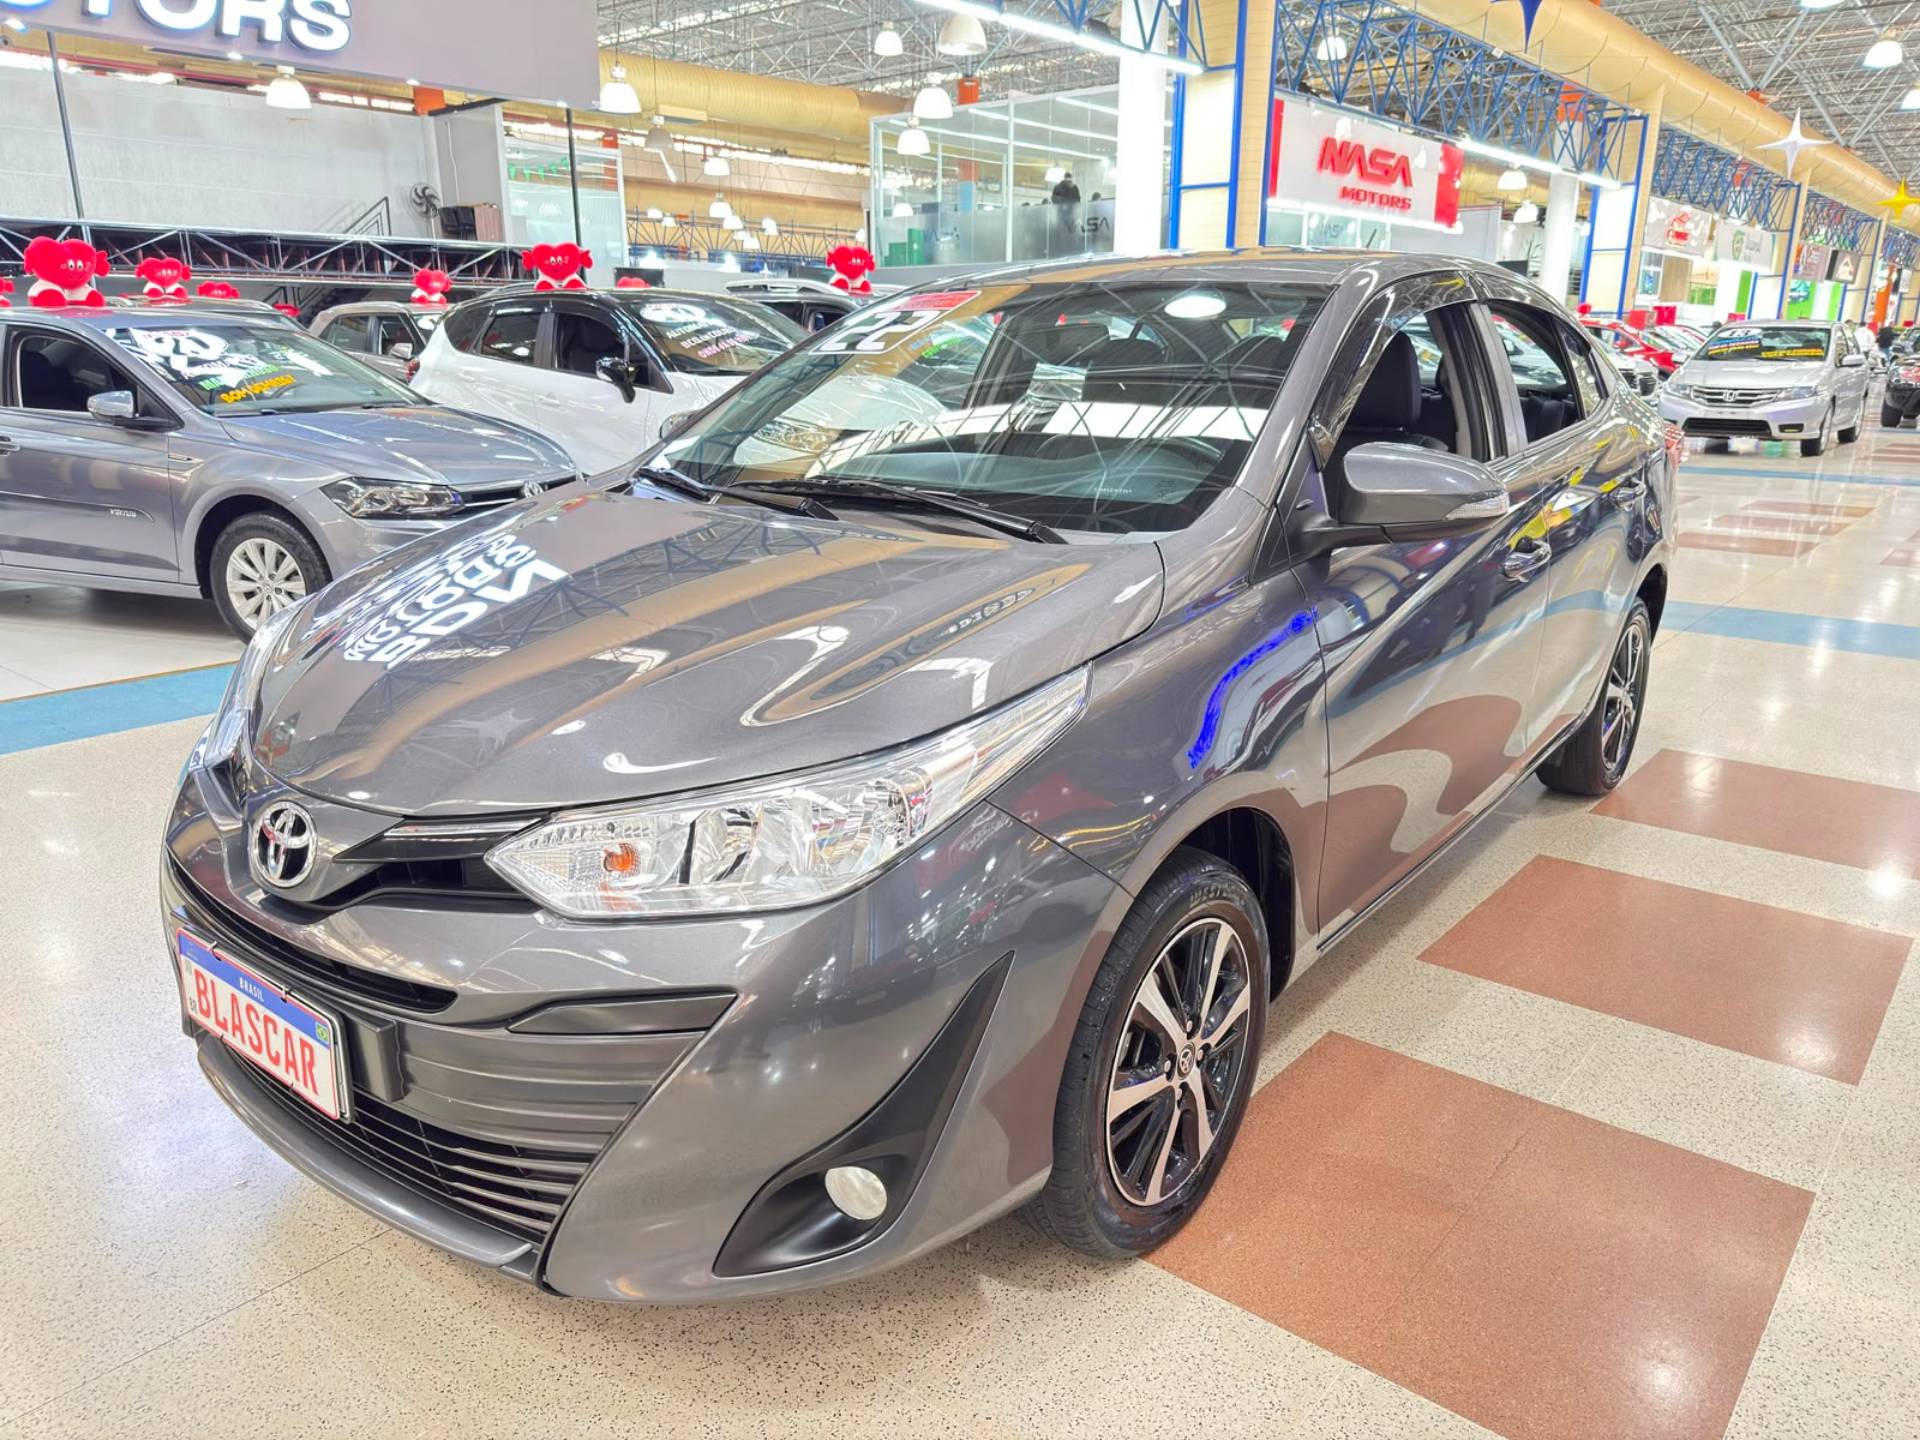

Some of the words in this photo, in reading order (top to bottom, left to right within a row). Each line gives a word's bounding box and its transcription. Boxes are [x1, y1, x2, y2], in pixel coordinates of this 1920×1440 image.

[1317, 136, 1414, 188] NASA
[1339, 186, 1412, 210] MOTORS
[819, 310, 942, 351] 22
[239, 976, 264, 1001] BRASIL
[195, 969, 318, 1096] BLASCAR
